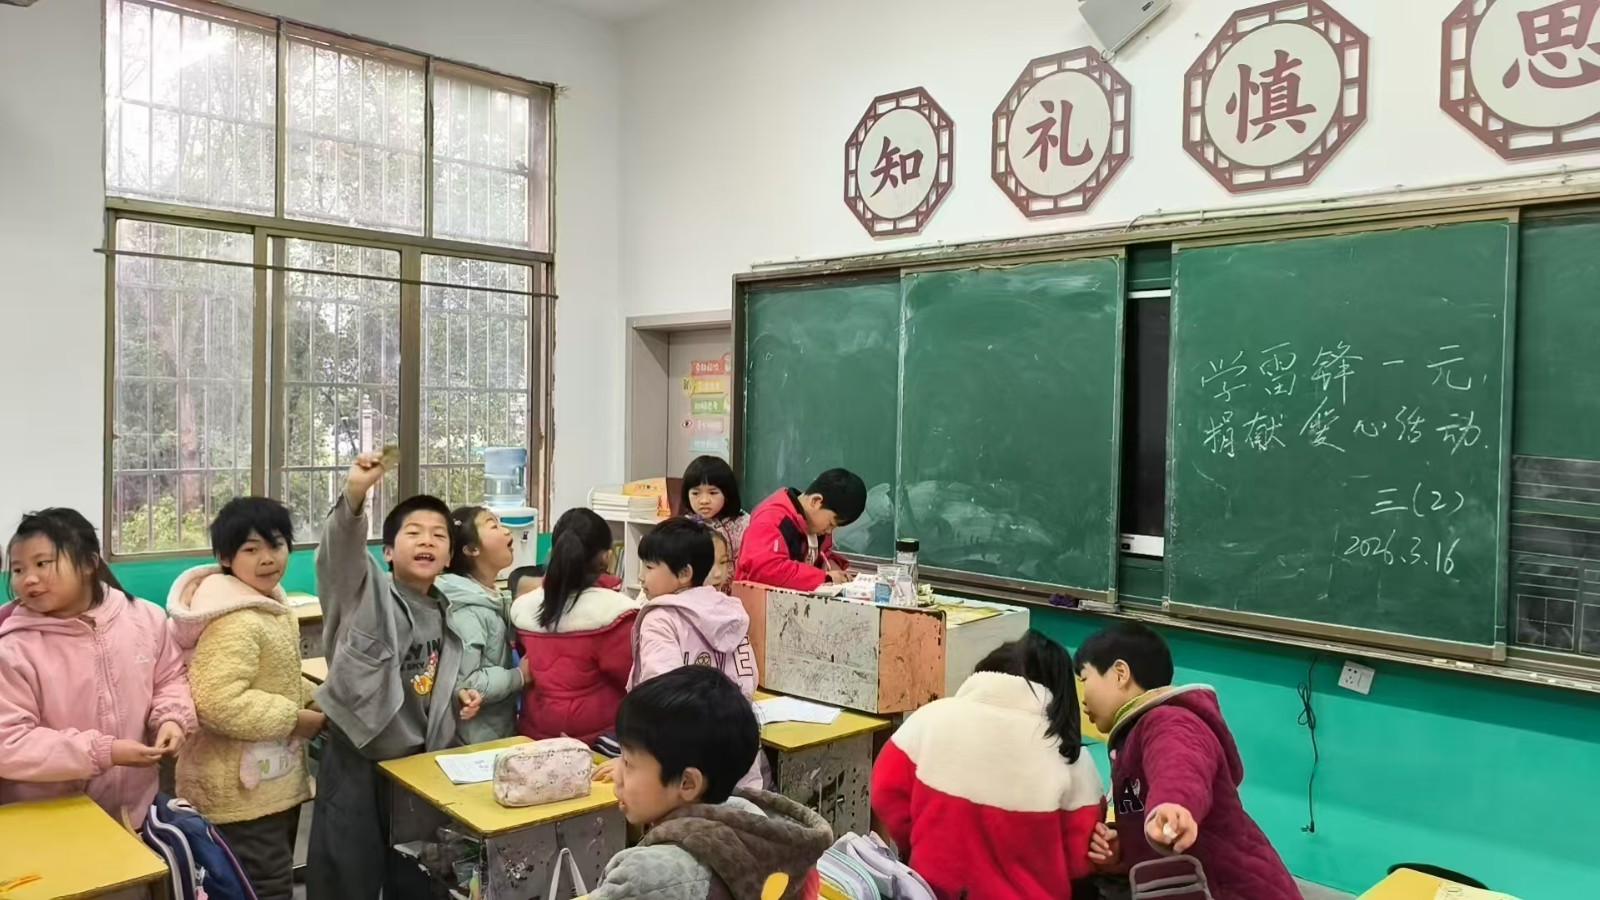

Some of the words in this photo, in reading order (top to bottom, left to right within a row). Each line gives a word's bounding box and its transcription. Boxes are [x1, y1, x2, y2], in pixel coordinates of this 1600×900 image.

[1501, 0, 1600, 89] 思
[1022, 99, 1094, 173] 礼
[1225, 49, 1317, 144] 慎
[869, 136, 924, 198] 知
